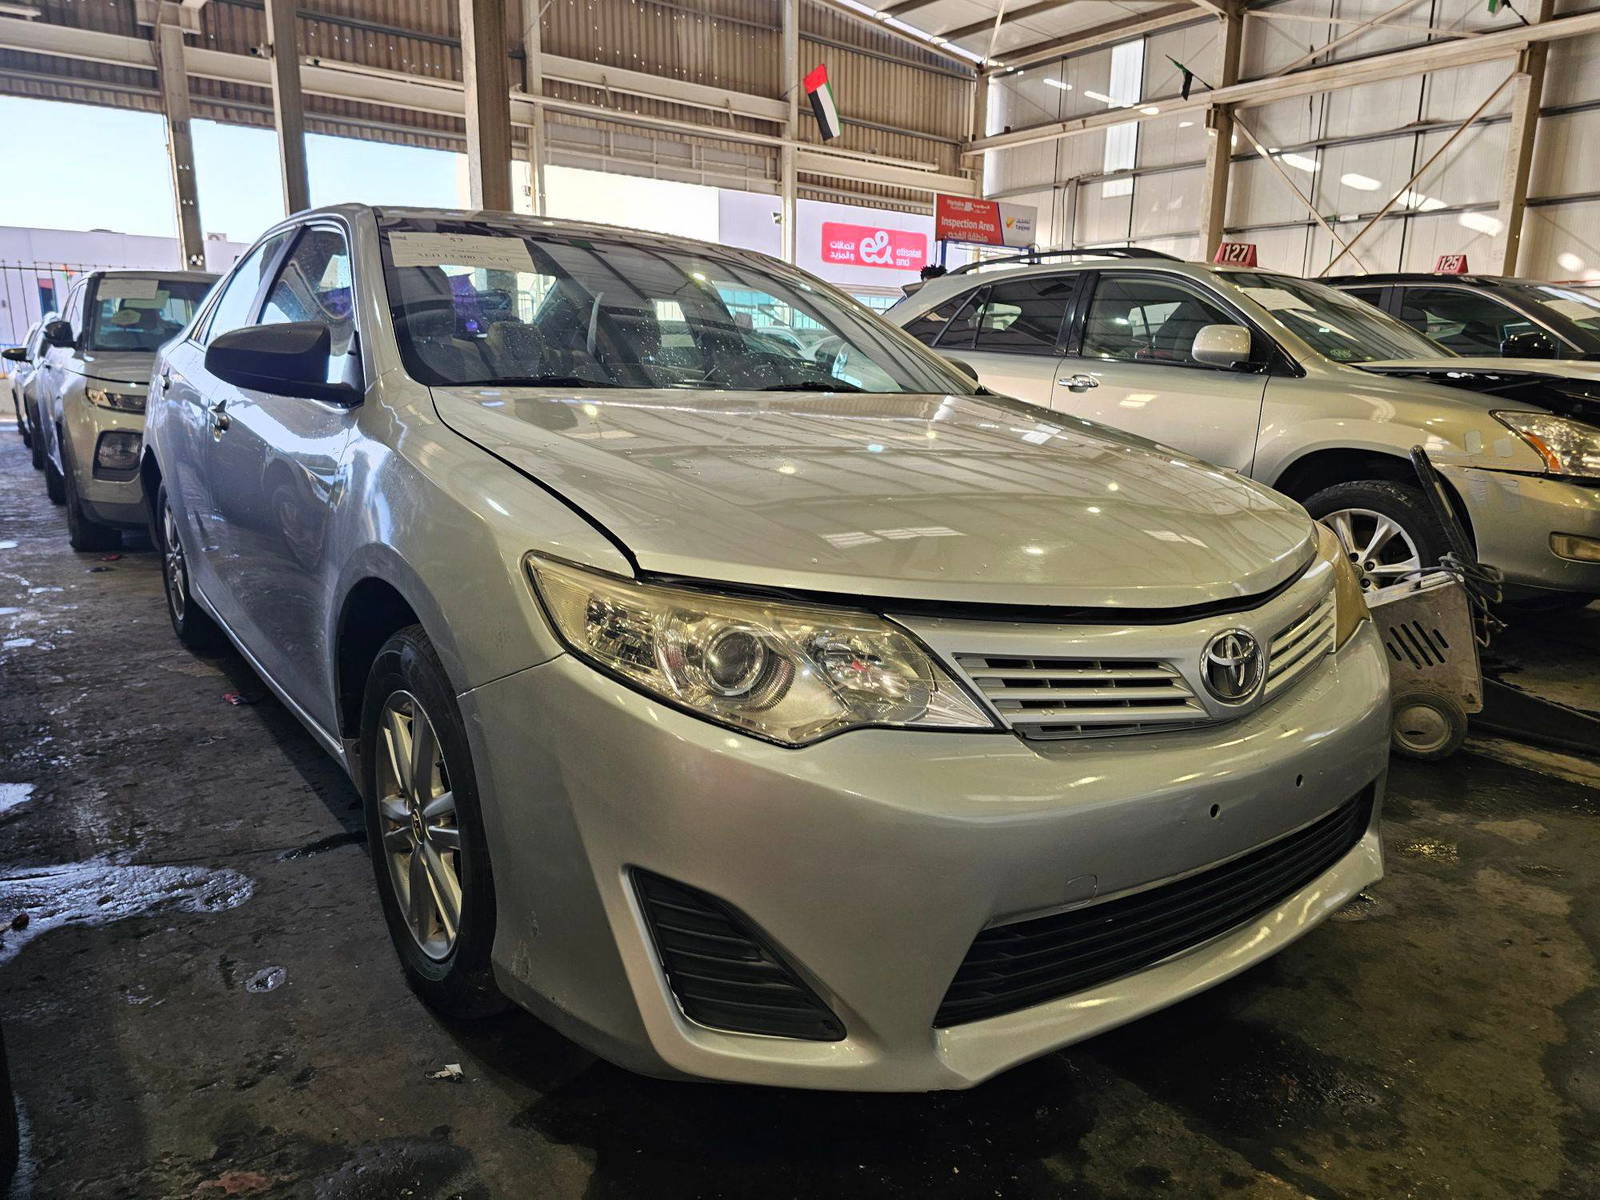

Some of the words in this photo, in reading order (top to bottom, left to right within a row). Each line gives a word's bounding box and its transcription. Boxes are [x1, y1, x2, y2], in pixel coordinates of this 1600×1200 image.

[941, 216, 978, 230] Inspection
[978, 221, 995, 232] Area
[1223, 243, 1249, 262] 127
[896, 258, 910, 266] and
[1440, 255, 1460, 271] 125
